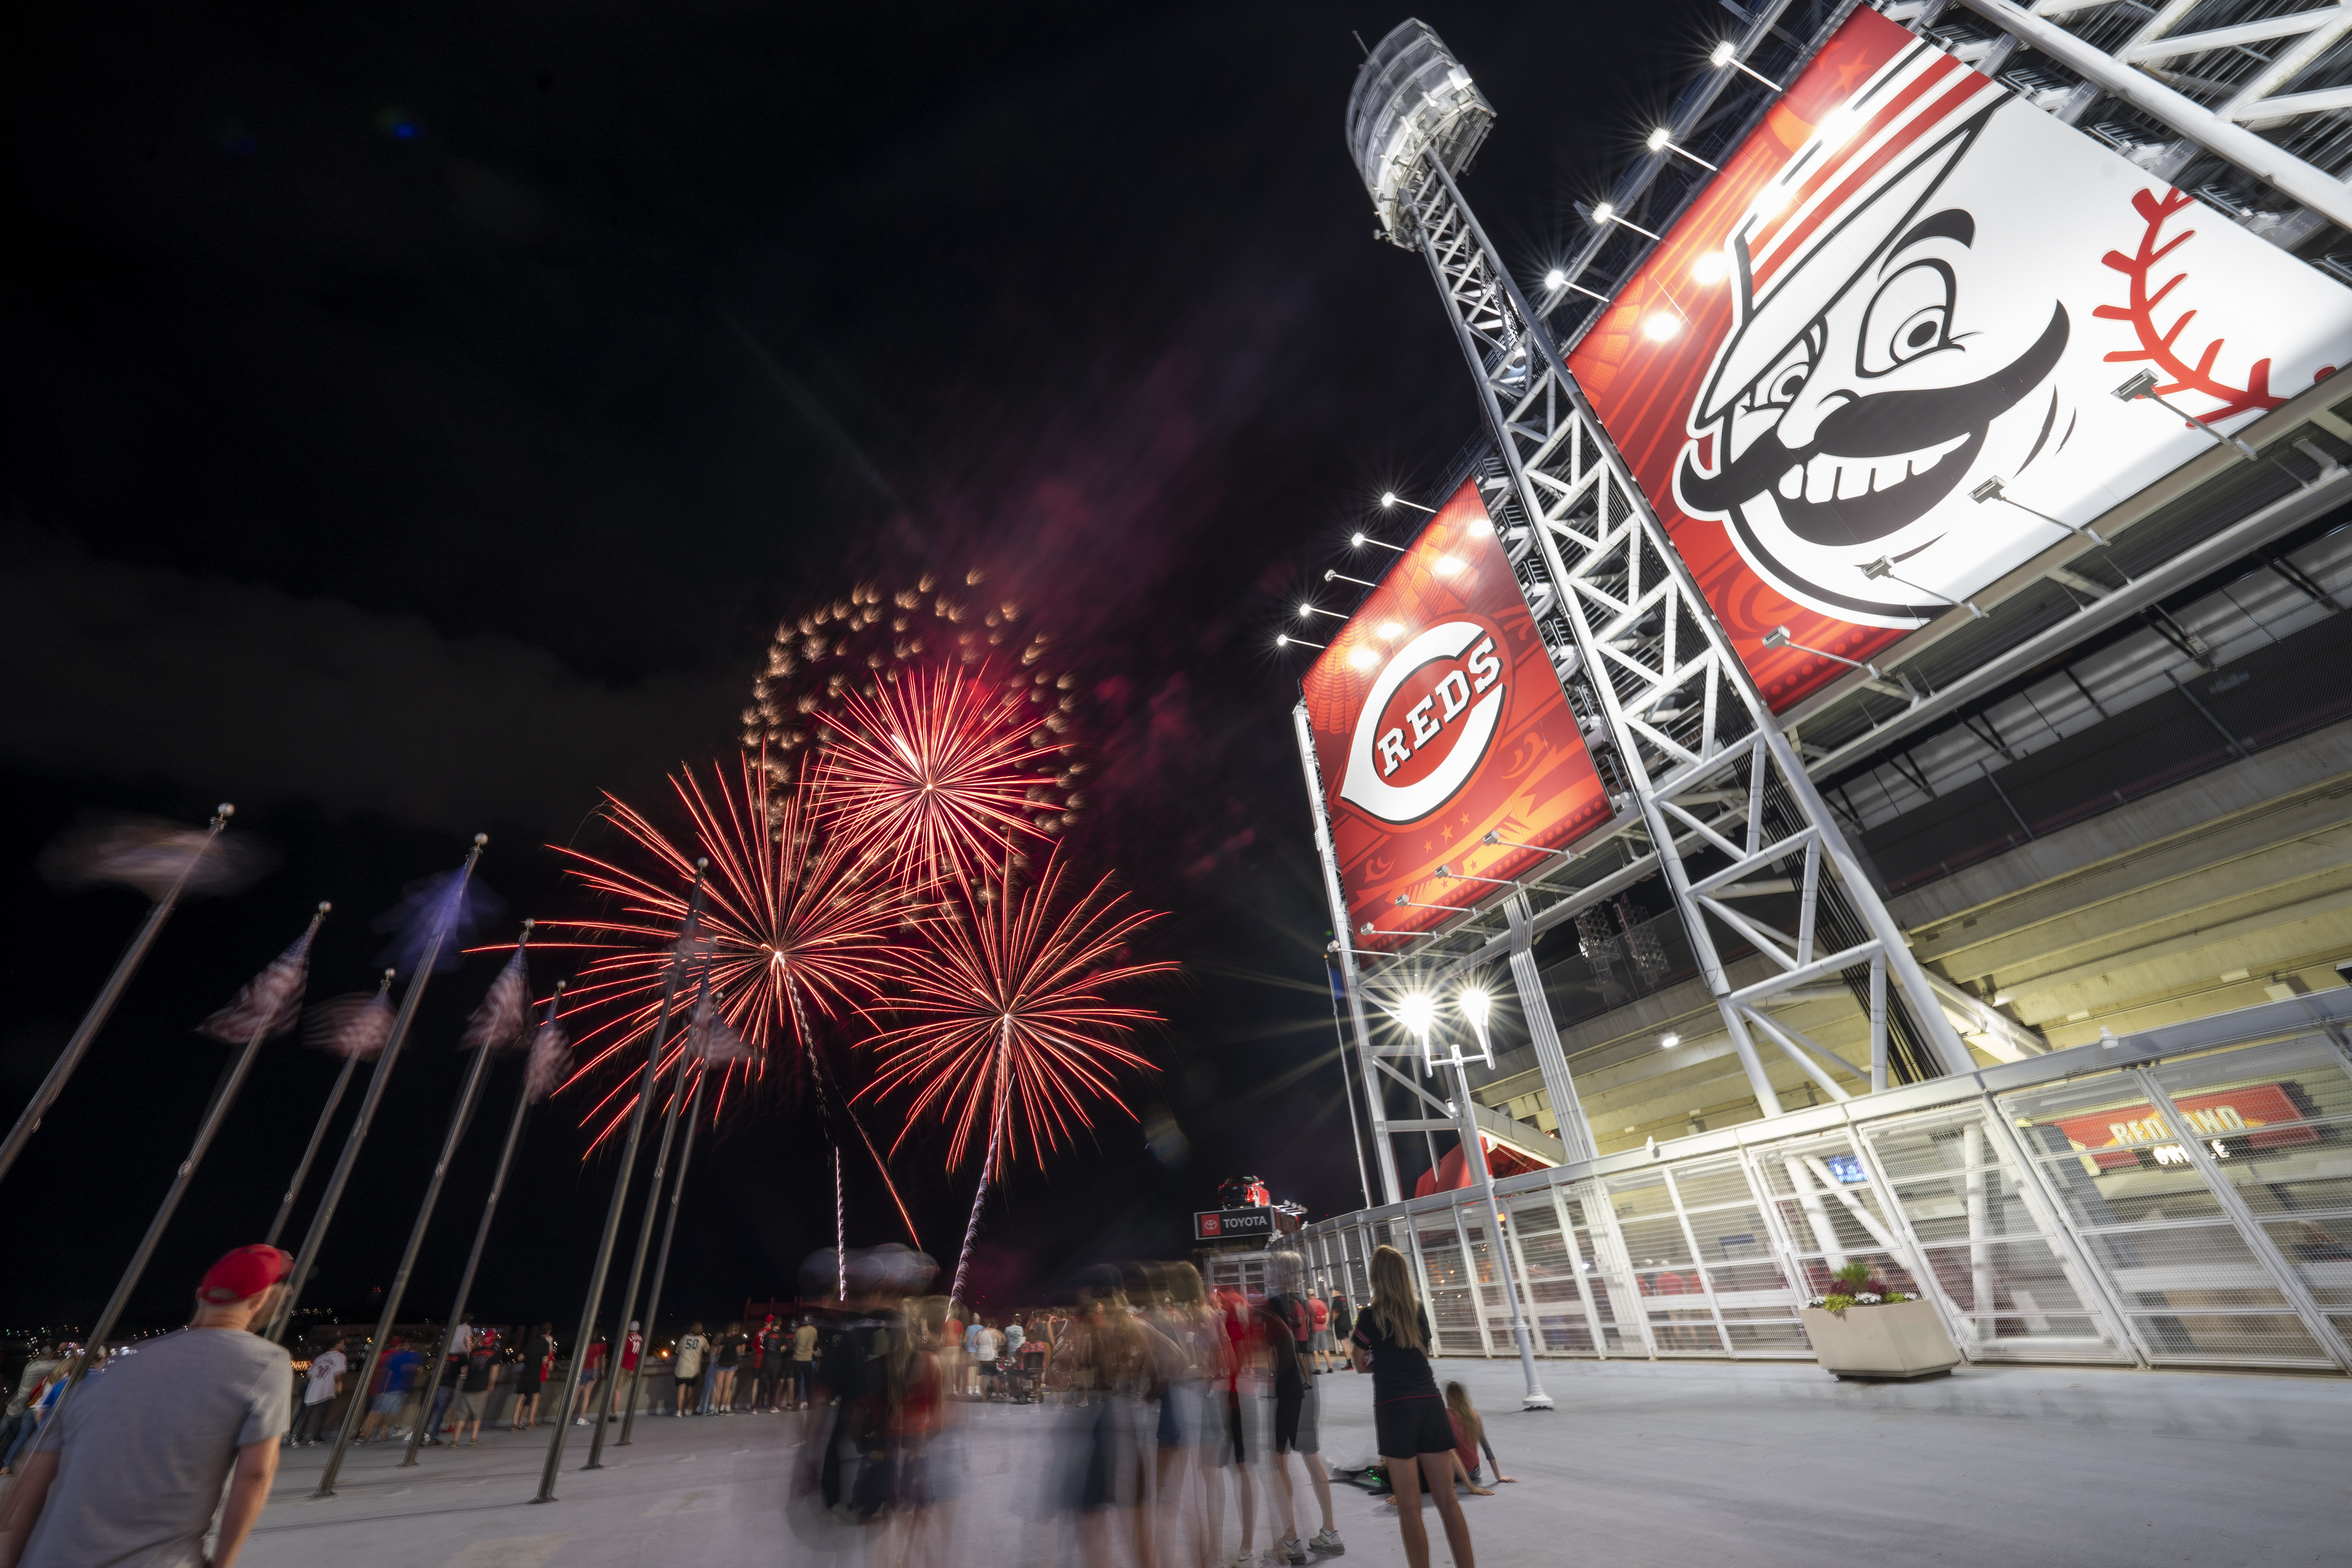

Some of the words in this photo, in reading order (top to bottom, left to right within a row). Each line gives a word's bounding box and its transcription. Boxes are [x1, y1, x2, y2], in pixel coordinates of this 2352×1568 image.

[1377, 636, 1504, 777] REDS
[2108, 1105, 2247, 1146] REDAND
[2153, 1139, 2230, 1165] GRIE
[1223, 1216, 1268, 1228] TOYOTA
[685, 1338, 699, 1350] 50
